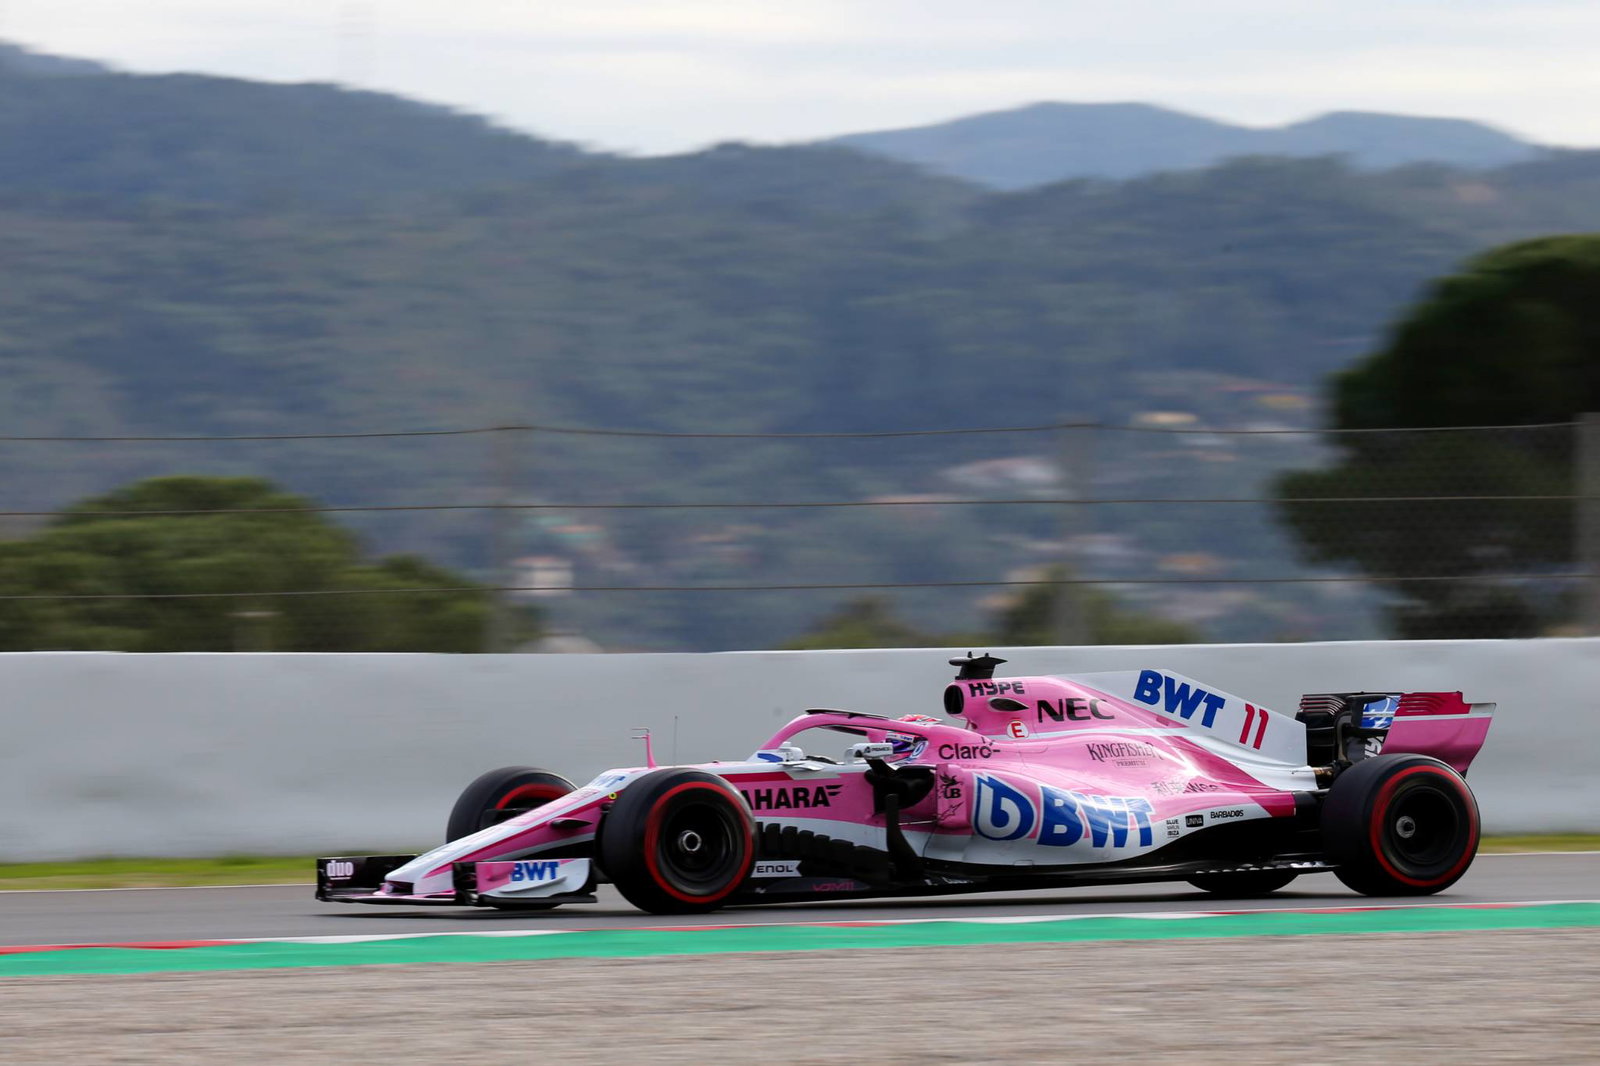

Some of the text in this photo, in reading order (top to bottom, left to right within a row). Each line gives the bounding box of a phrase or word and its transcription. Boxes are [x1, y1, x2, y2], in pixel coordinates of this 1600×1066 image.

[968, 681, 1026, 698] HYPE
[1036, 698, 1116, 724] NEC
[1133, 669, 1269, 750] BWT 11
[1010, 722, 1026, 739] E
[938, 743, 993, 760] Claro
[1086, 742, 1163, 762] KINGFISHER
[740, 786, 831, 811] AHARA
[1037, 786, 1154, 848] BWT
[1210, 810, 1244, 819] BARBADOS
[326, 860, 354, 877] duo
[510, 861, 560, 882] BWT
[756, 865, 794, 873] ENOL
